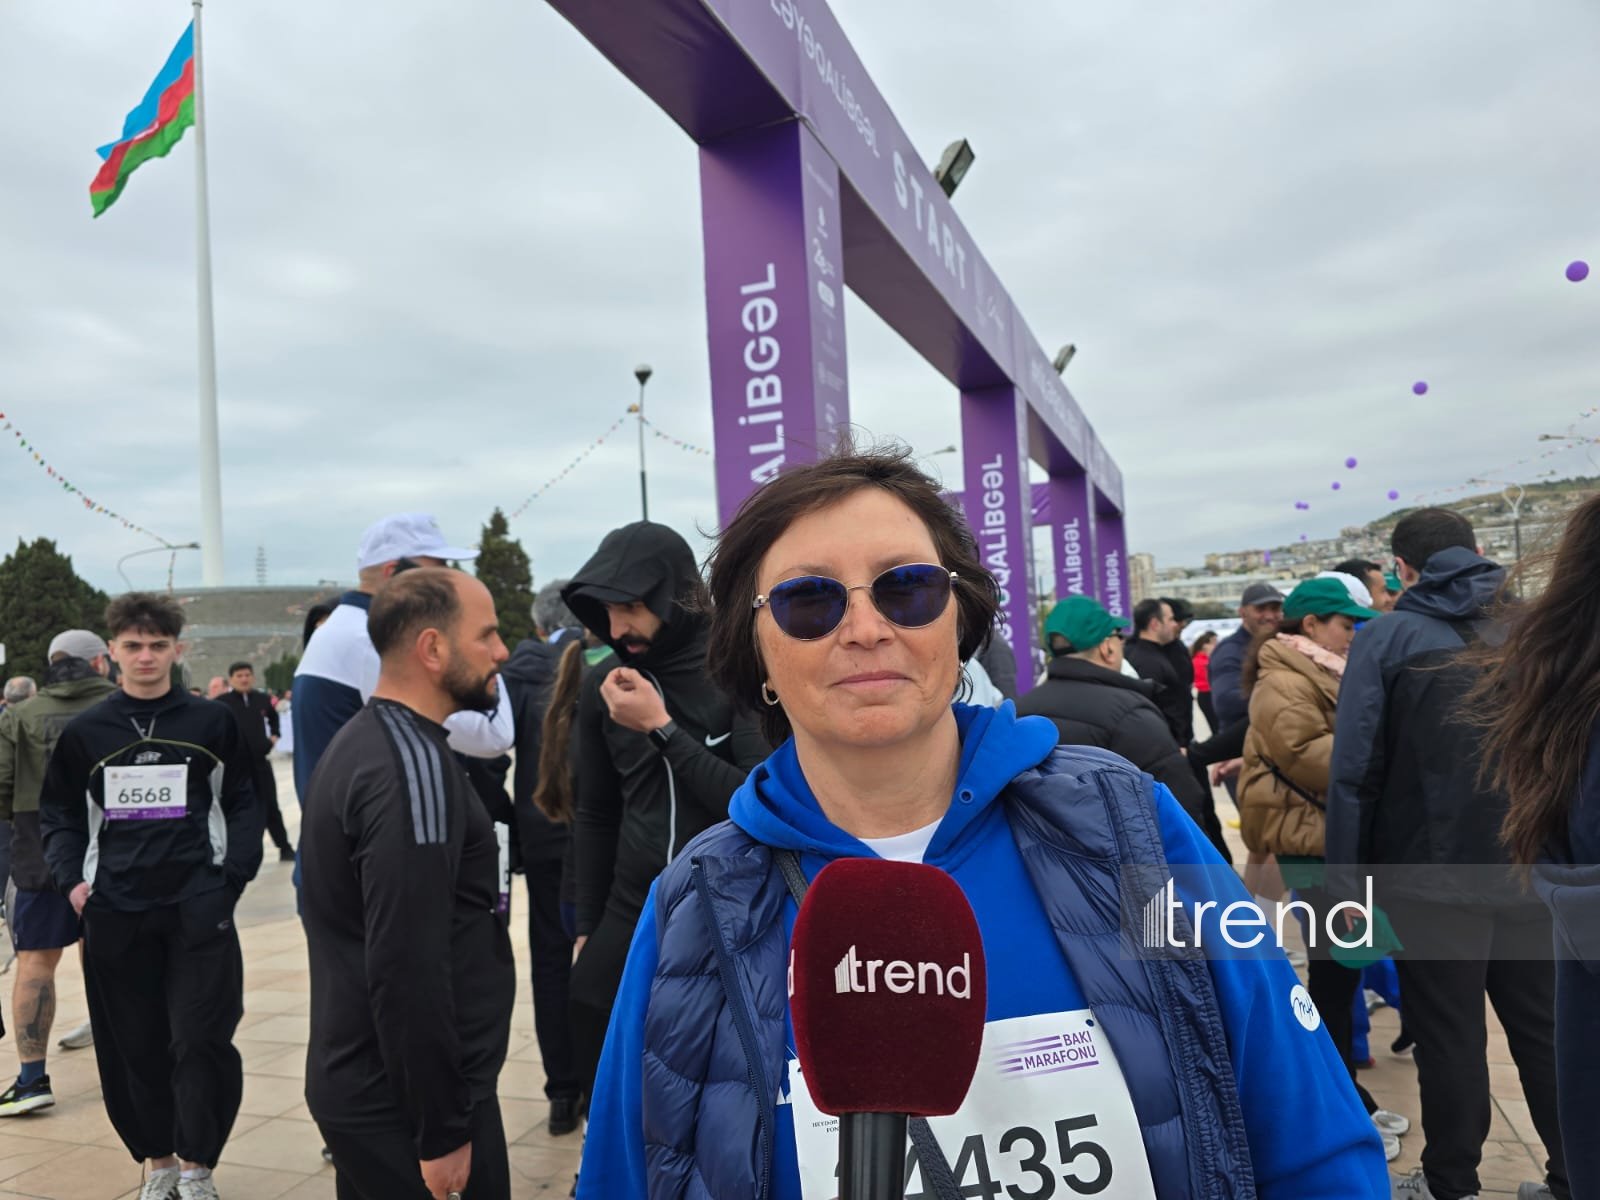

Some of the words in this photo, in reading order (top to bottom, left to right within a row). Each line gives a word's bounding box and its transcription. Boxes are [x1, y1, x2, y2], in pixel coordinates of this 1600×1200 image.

[893, 151, 966, 289] START
[118, 786, 171, 804] 6568
[849, 944, 971, 1000] trend
[1062, 1030, 1092, 1047] BAKI
[1024, 1045, 1097, 1069] MARAFONU
